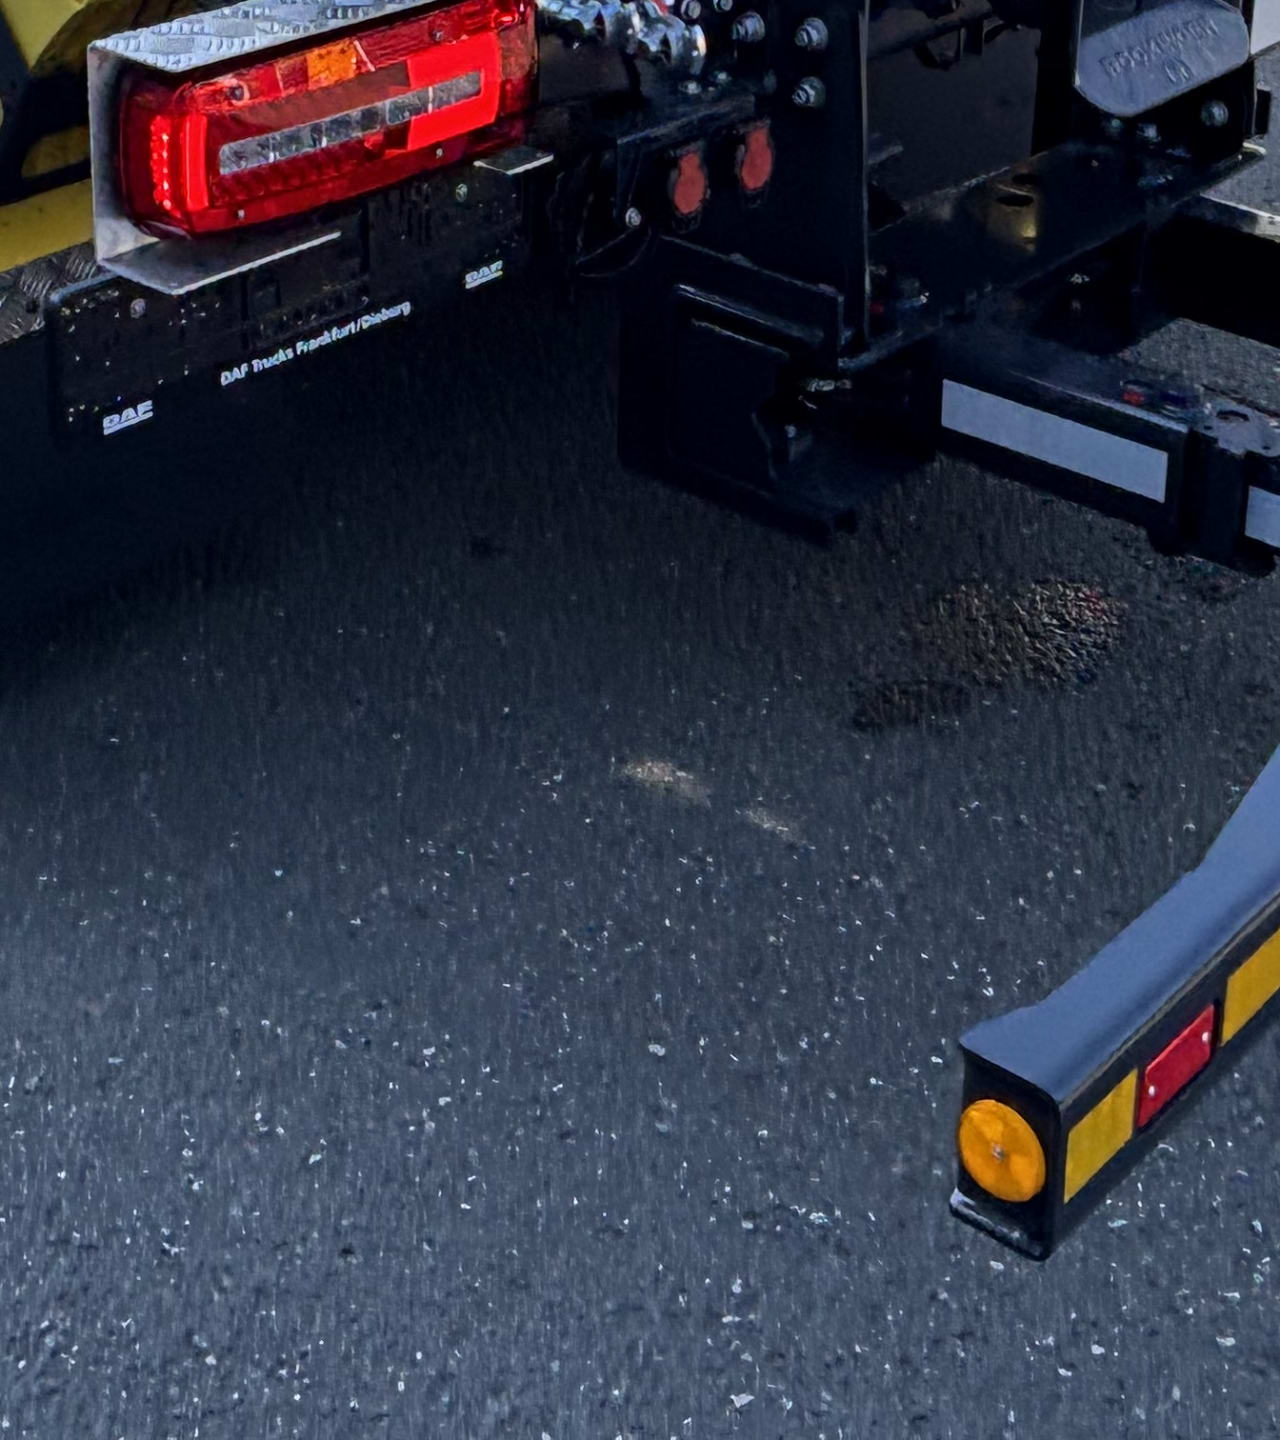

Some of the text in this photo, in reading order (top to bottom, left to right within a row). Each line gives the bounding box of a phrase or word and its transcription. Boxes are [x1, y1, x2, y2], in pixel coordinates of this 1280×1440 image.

[465, 260, 503, 284] DAF
[221, 363, 248, 386] DAF
[252, 347, 294, 373] Trucks
[103, 400, 153, 430] DAF
